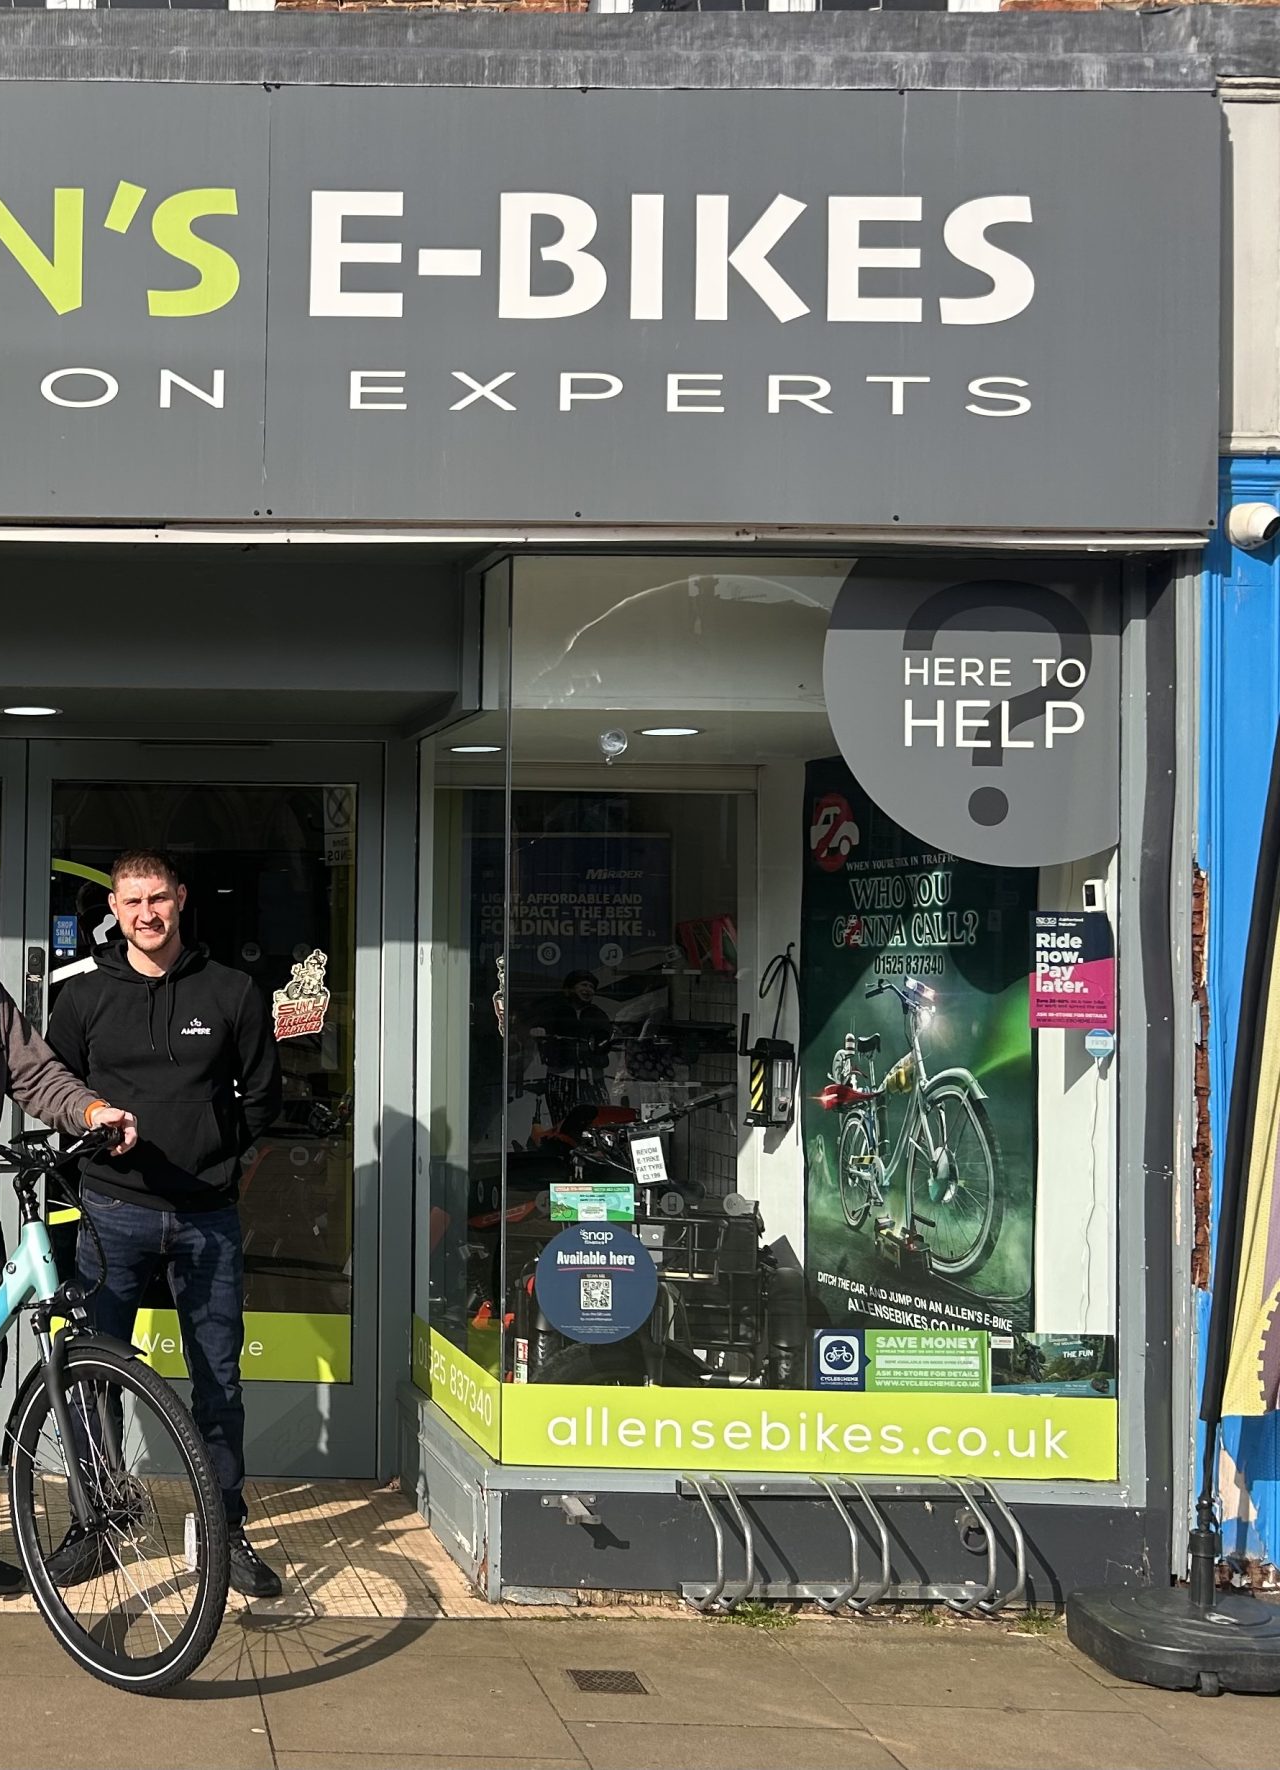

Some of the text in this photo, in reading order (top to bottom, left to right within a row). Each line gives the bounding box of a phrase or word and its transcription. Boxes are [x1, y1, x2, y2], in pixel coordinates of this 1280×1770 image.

[310, 191, 1035, 325] E-BIKES
[350, 371, 1032, 417] EXPERTS
[903, 657, 1086, 688] HERE TO
[904, 699, 1086, 749] HELP
[849, 871, 953, 910] WHO YOU
[481, 893, 642, 906] LIGT, AFFORDABLE AND
[572, 906, 604, 918] THE
[606, 906, 642, 918] BEST
[579, 920, 643, 937] E-BIKE
[912, 910, 979, 946] CALL?
[1036, 933, 1083, 949] Ride
[874, 954, 944, 975] 01525 837340
[1036, 951, 1084, 964] now.
[1036, 964, 1075, 980] Pay
[1036, 978, 1089, 993] later.
[180, 1027, 211, 1035] AMPERE
[581, 1230, 614, 1244] snap
[556, 1250, 636, 1266] Available here
[817, 1271, 1013, 1333] DITCH THE CAR, AND JUMP ON AN ALLEN'S E-BIKE
[133, 1332, 264, 1357] Wele
[875, 1336, 917, 1349] SAVE
[921, 1337, 979, 1349] MONEY
[1063, 1350, 1094, 1359] THE FUN
[450, 1363, 492, 1428] 837340
[546, 1406, 1070, 1459] allensebikes.co.uk
